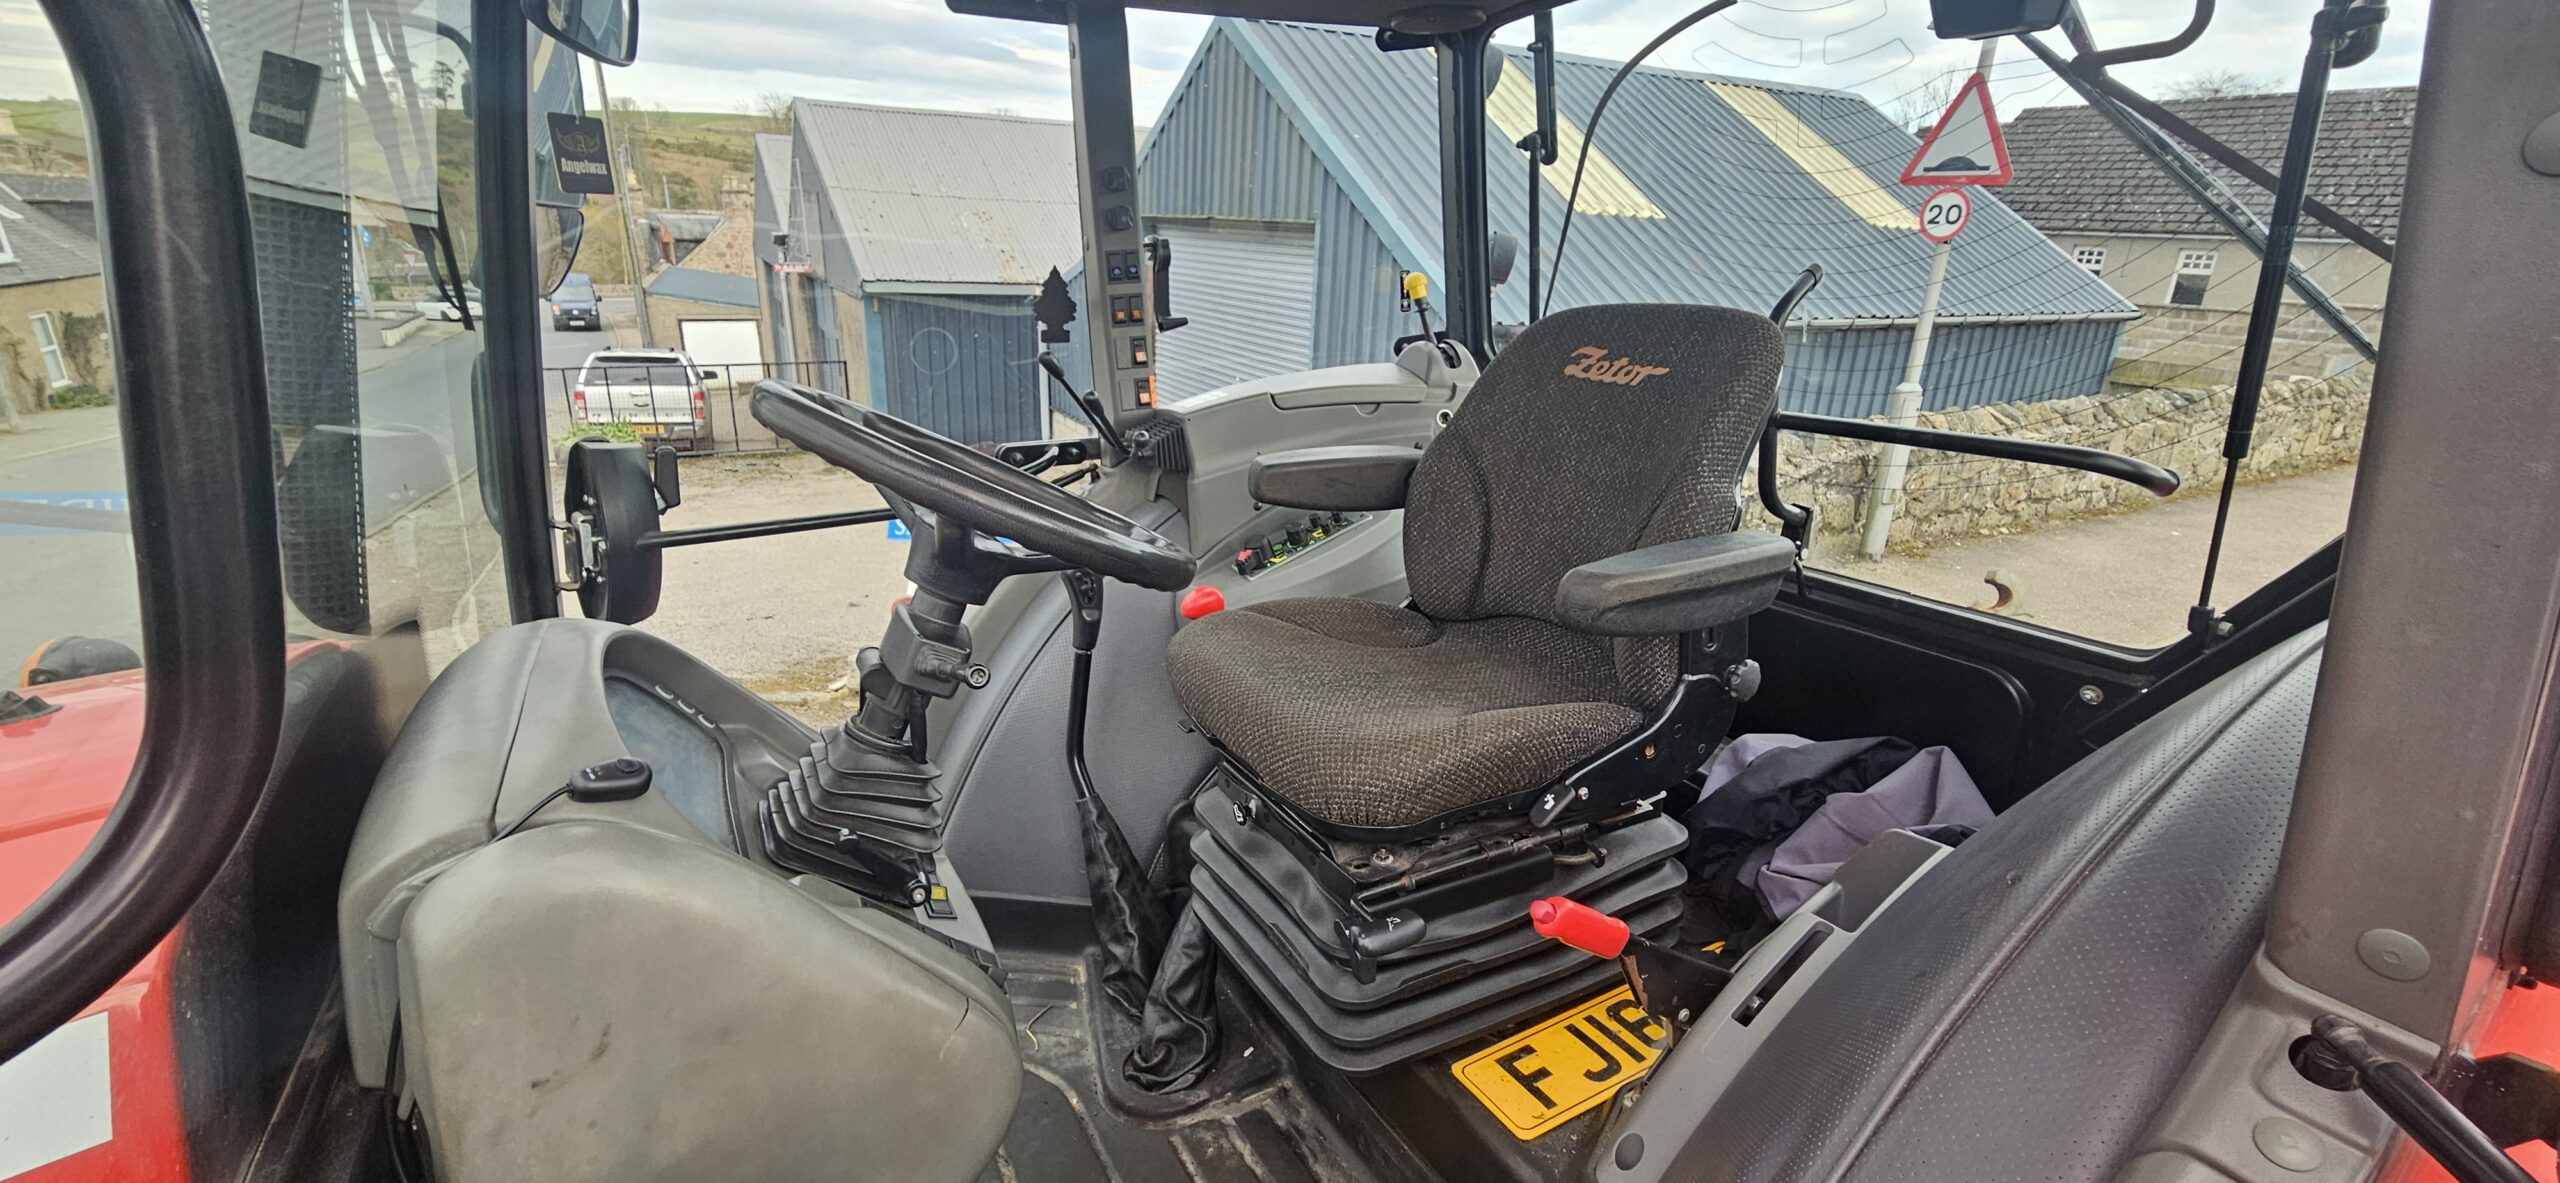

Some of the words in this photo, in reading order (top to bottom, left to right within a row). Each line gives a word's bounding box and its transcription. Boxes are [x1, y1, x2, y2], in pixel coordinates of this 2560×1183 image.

[561, 157, 607, 175] Angelwax
[1927, 204, 1962, 225] 20
[1563, 346, 1670, 386] Zetor
